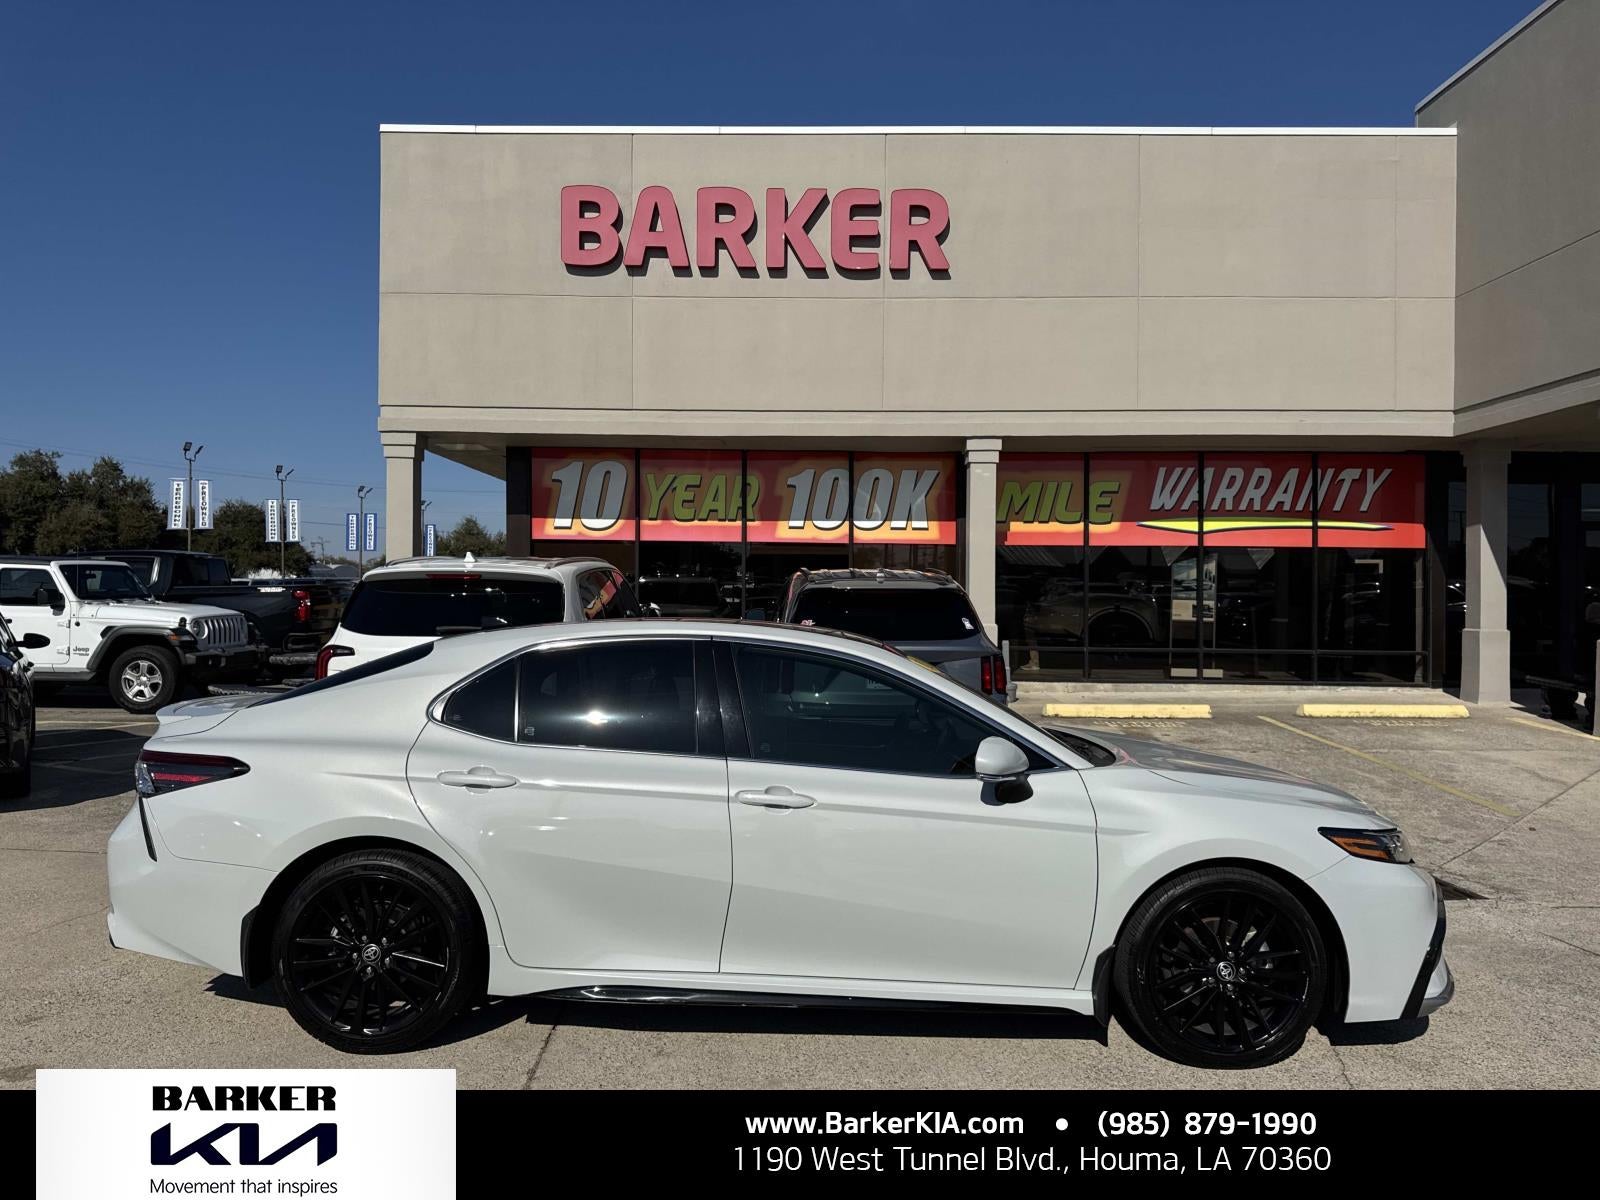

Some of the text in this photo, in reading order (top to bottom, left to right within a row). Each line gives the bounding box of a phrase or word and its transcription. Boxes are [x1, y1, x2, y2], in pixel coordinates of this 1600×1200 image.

[561, 184, 951, 280] BARKER
[550, 460, 1393, 533] 10 YEAR 100K MILE WARRANTY
[72, 645, 90, 653] Jeep
